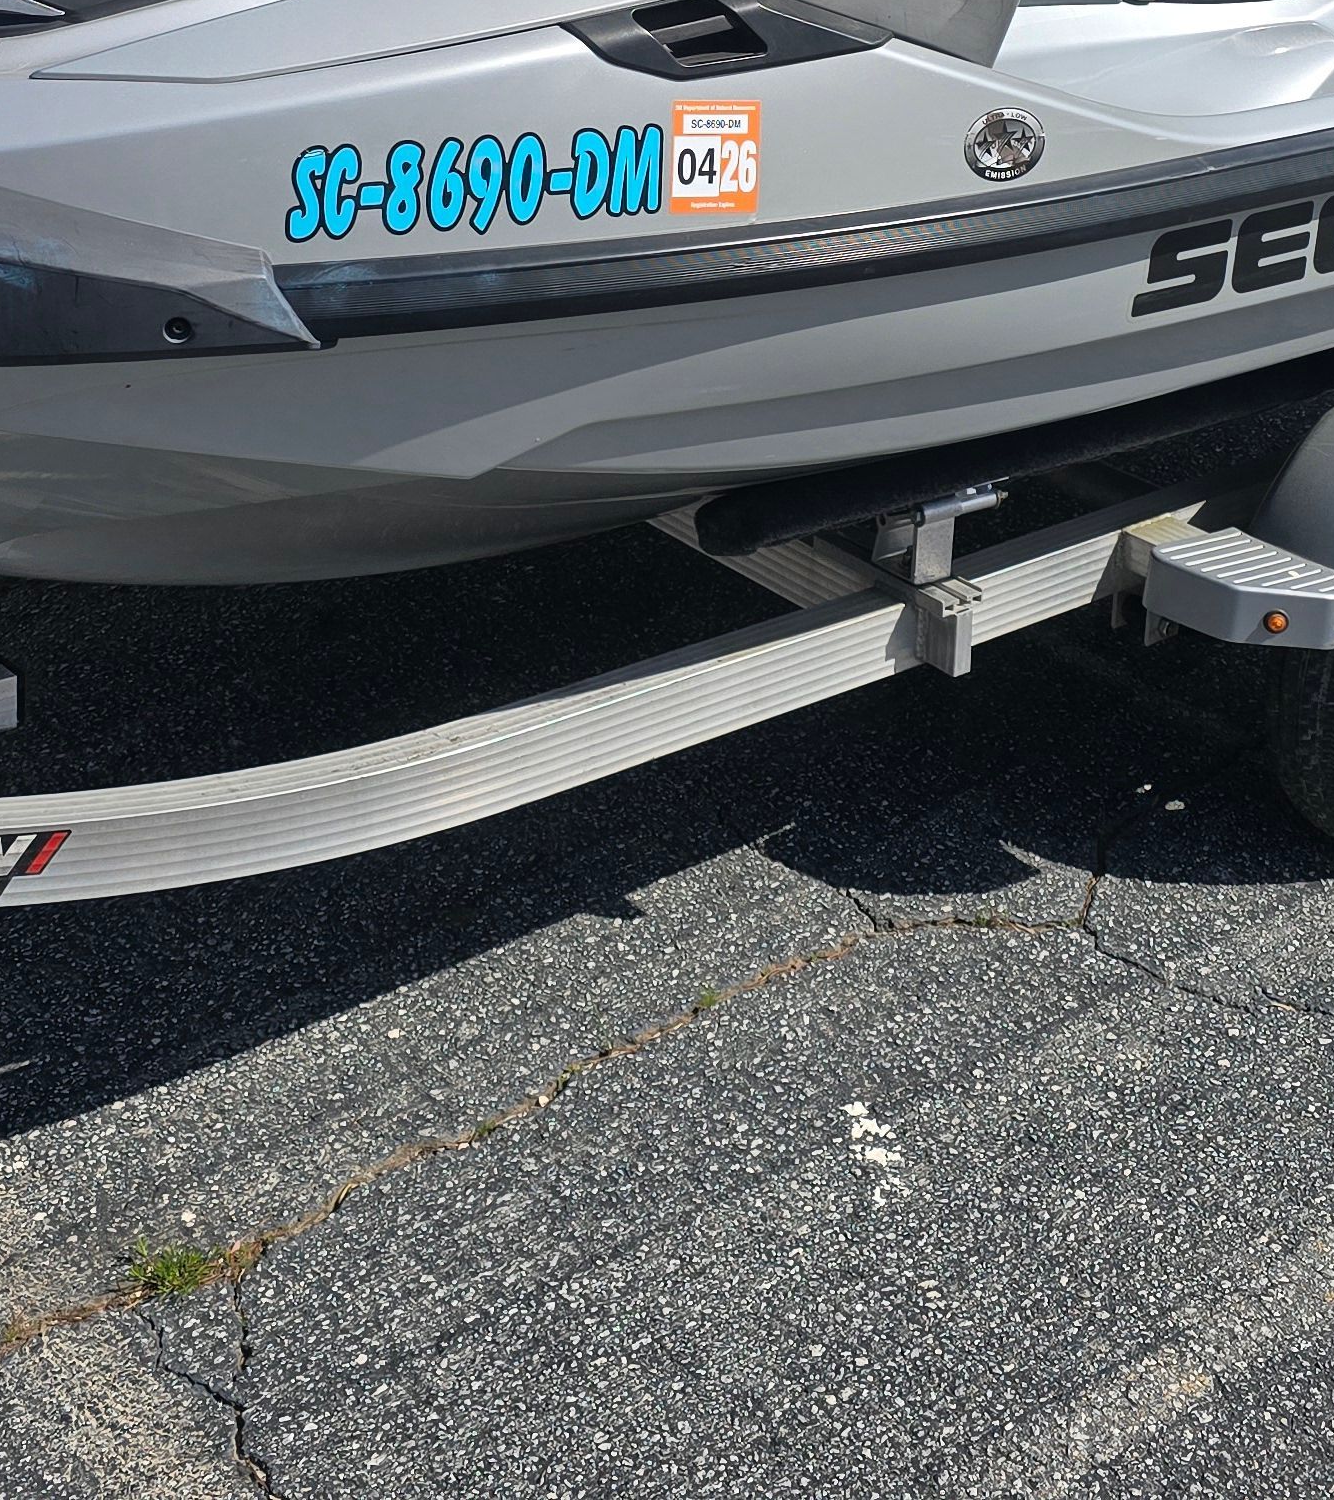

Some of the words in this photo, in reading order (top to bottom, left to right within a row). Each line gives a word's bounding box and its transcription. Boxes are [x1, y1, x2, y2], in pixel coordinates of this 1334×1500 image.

[691, 119, 742, 129] SC-8690-DM
[285, 124, 664, 242] SC-8690-DM
[677, 148, 717, 186] 04
[719, 139, 757, 193] 26
[985, 164, 1027, 179] EMISSION
